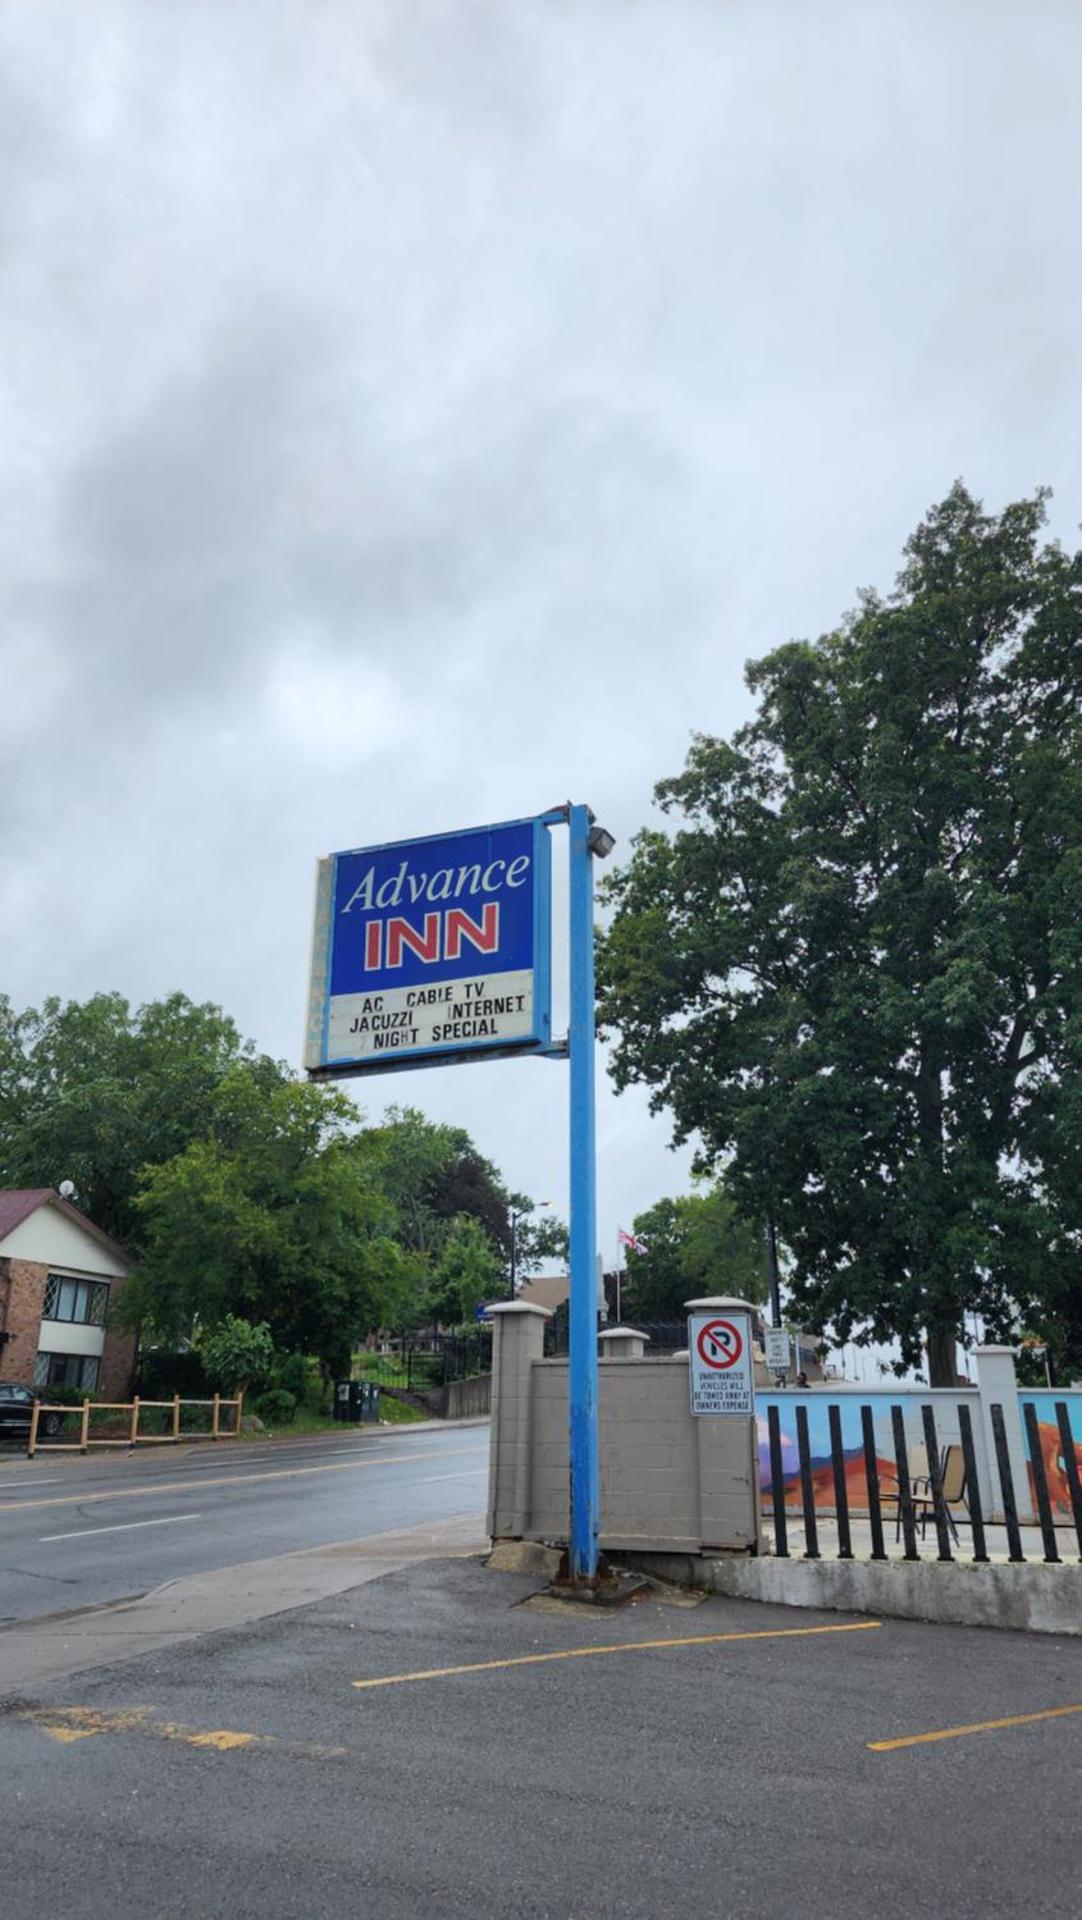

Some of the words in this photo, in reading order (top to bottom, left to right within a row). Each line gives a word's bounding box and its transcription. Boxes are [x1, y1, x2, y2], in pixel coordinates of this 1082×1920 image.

[341, 855, 530, 913] Advance
[364, 901, 499, 972] INN
[350, 1011, 412, 1033] JACUZZI
[448, 995, 525, 1019] INTERNET
[362, 997, 383, 1013] AC
[464, 982, 485, 999] TV
[374, 1028, 419, 1049] NIGHT
[432, 1018, 498, 1042] SPECIAL
